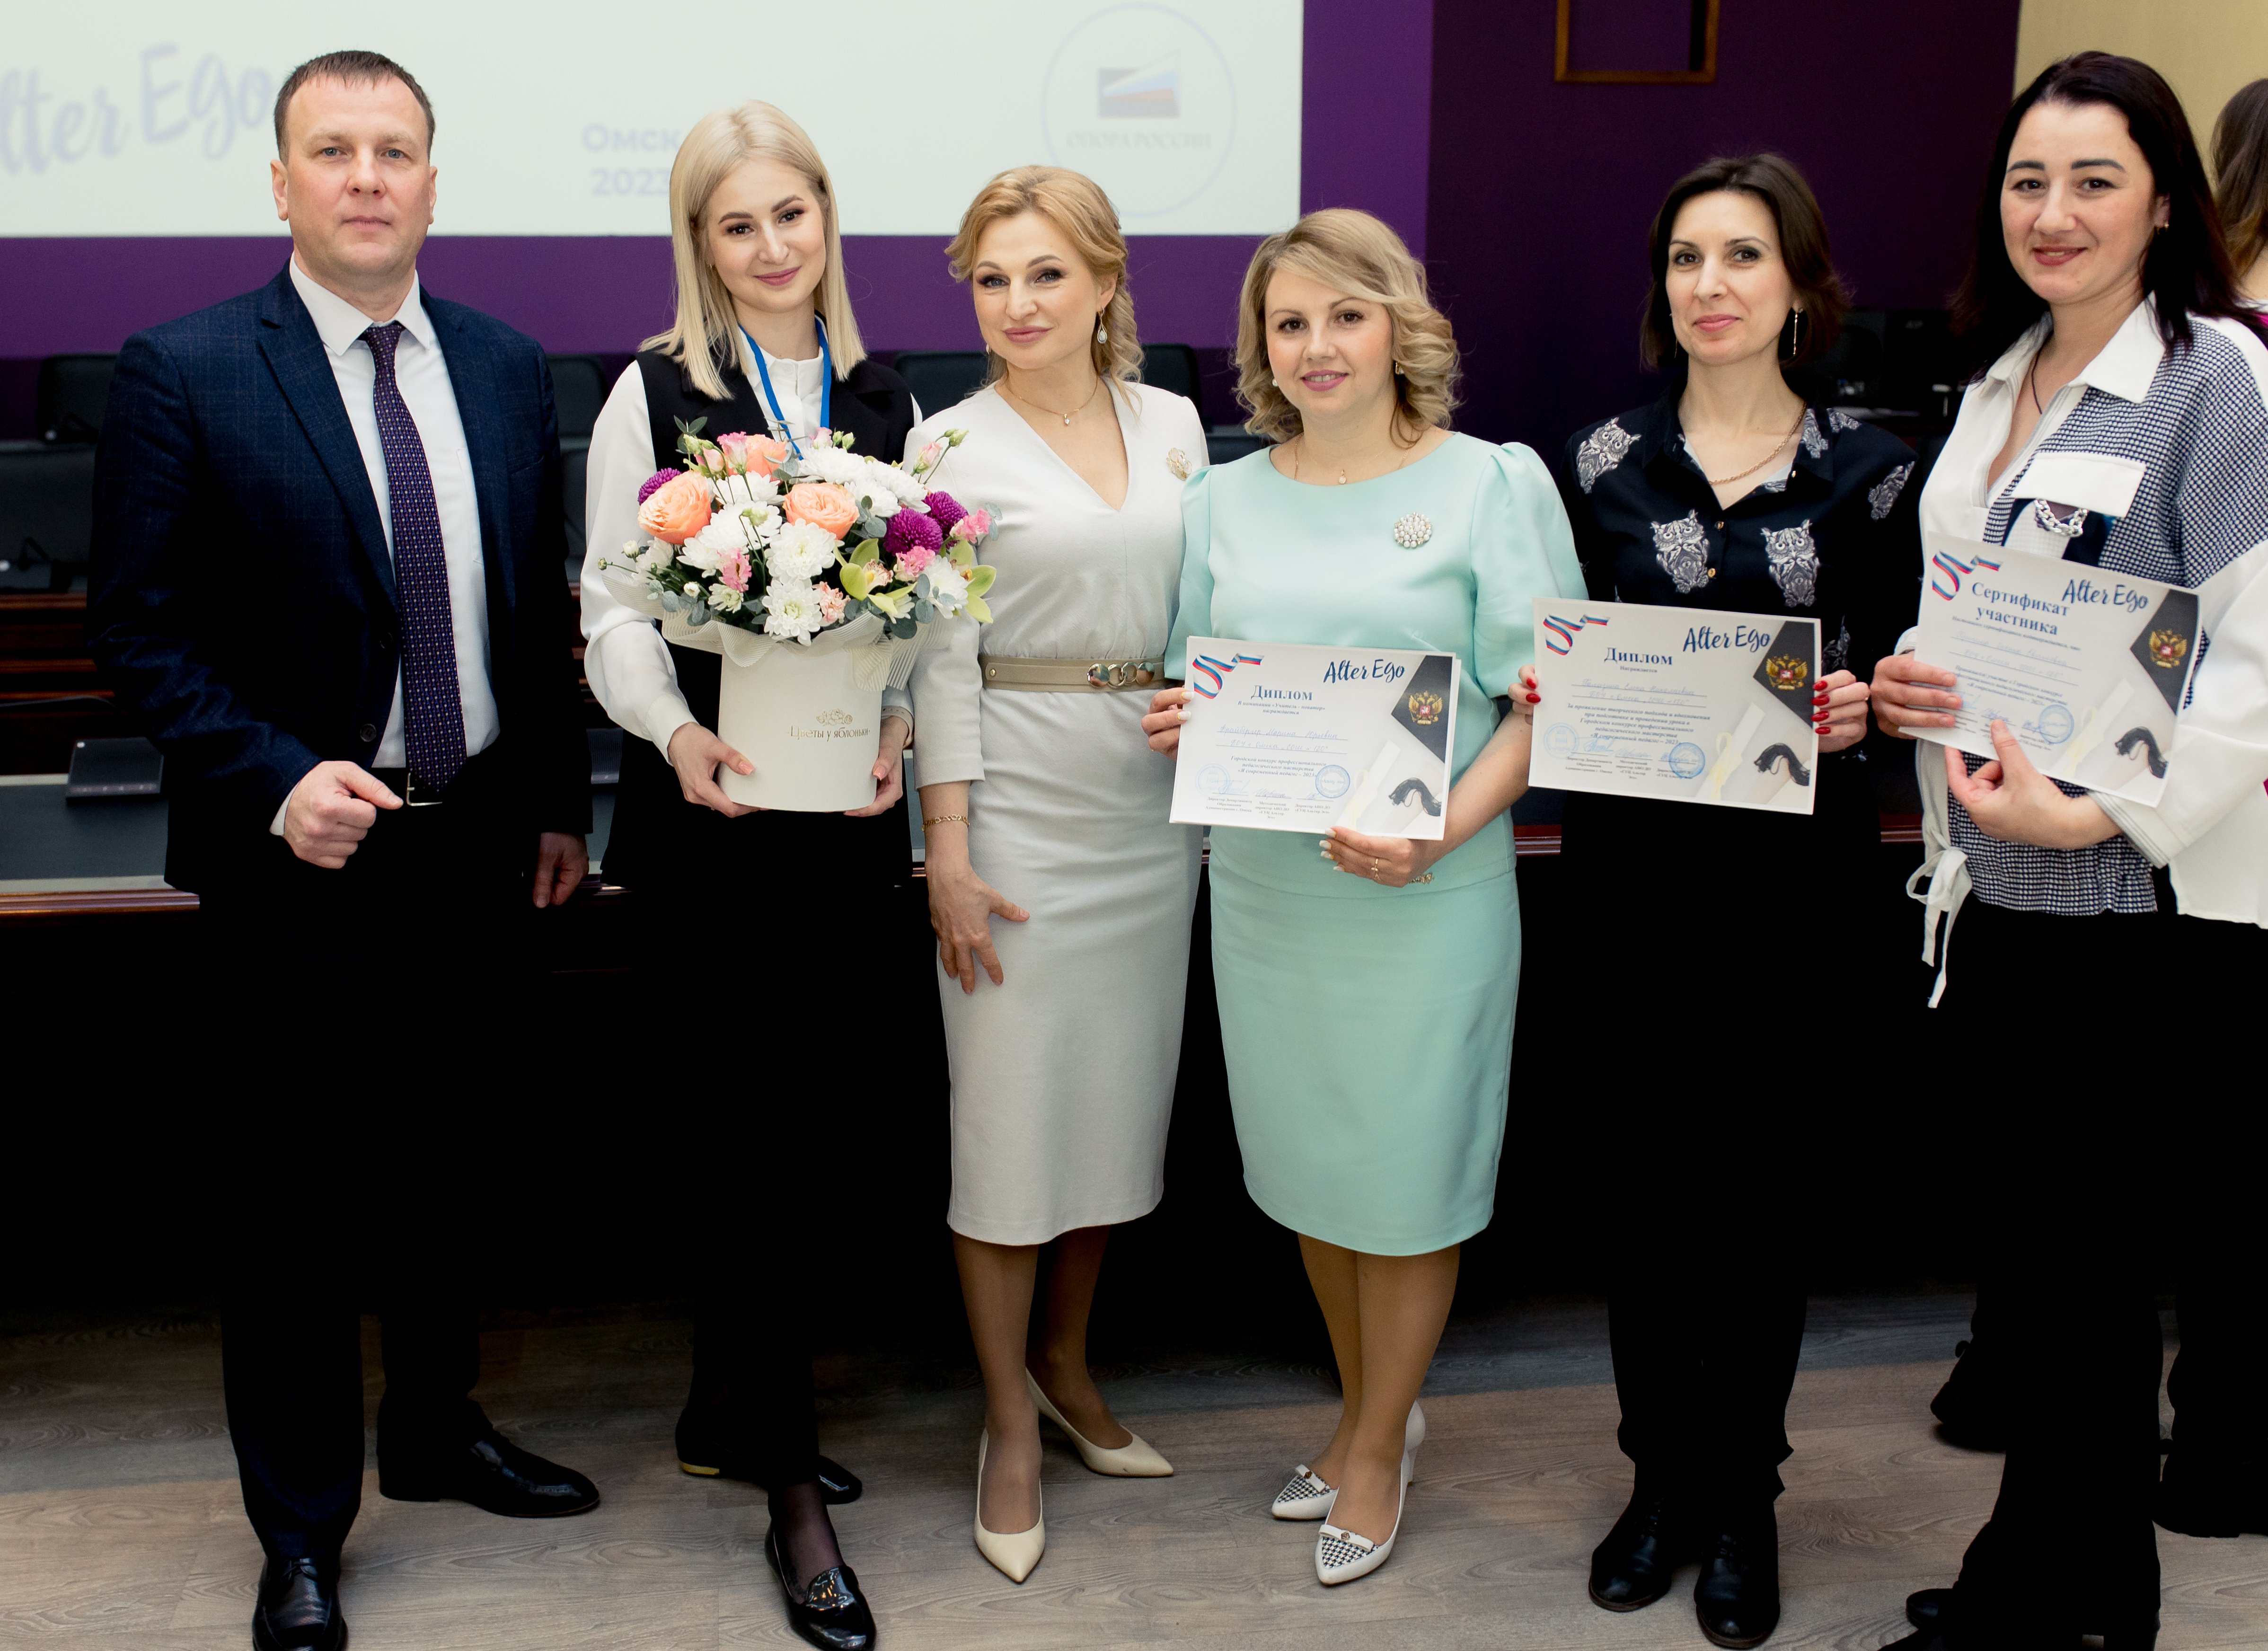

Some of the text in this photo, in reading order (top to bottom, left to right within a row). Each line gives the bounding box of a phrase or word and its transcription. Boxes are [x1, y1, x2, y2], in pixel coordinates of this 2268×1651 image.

[0, 43, 275, 177] lter Ego
[581, 122, 682, 152] Омск
[590, 168, 670, 196] 2023
[1972, 582, 2070, 617] Сертификат
[2061, 579, 2148, 613] Alter Ego
[1976, 607, 2058, 635] участника
[1683, 626, 1770, 653] Alter Ego
[1604, 647, 1673, 665] Диплом
[1323, 659, 1405, 684] Alter Ego
[1251, 685, 1313, 701] Диплом
[790, 725, 869, 742] Цветы у яблоньки
[1231, 755, 1257, 764] Городской
[1278, 759, 1326, 767] профессионального
